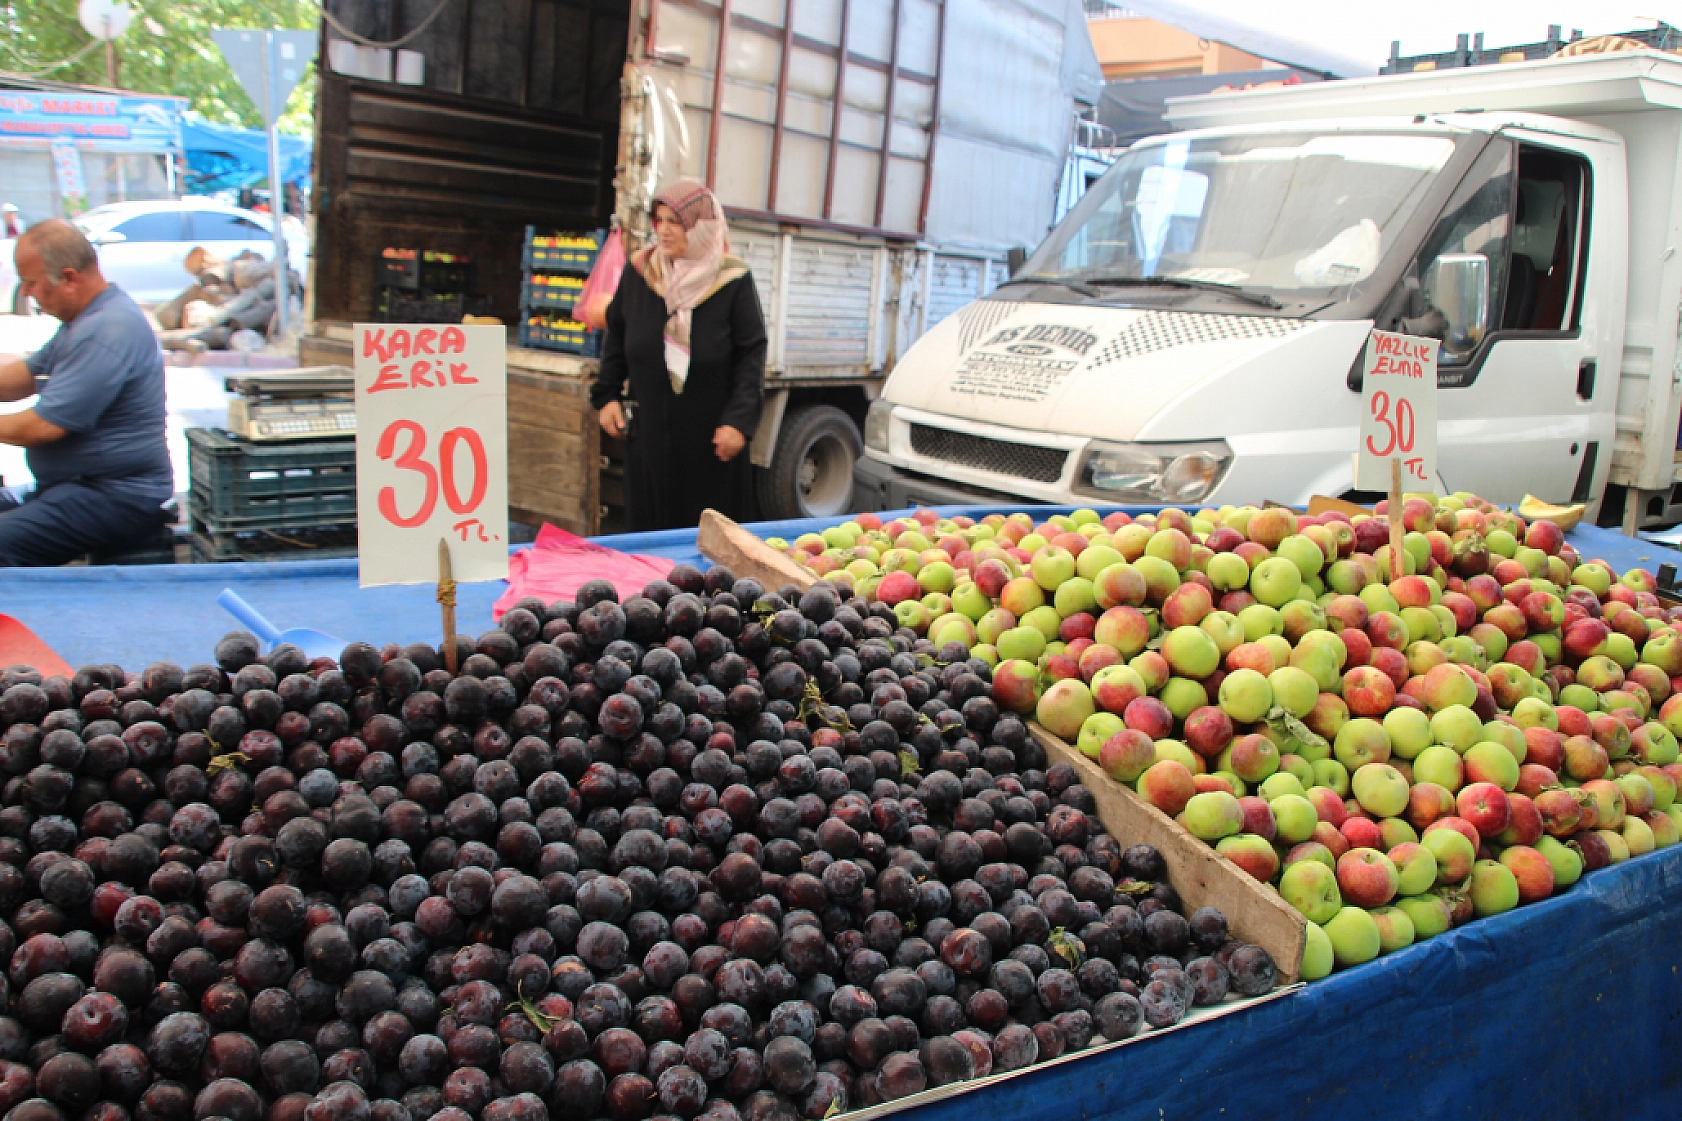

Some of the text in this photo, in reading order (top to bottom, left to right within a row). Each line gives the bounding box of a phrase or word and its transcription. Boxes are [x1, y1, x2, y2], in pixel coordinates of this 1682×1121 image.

[42, 98, 117, 116] MARKET
[363, 327, 466, 363] KARA
[1373, 332, 1431, 363] YAZLIK
[1370, 356, 1423, 379] ELMA
[1366, 390, 1415, 457] 30
[376, 419, 488, 528] 30
[1404, 457, 1428, 480] TL
